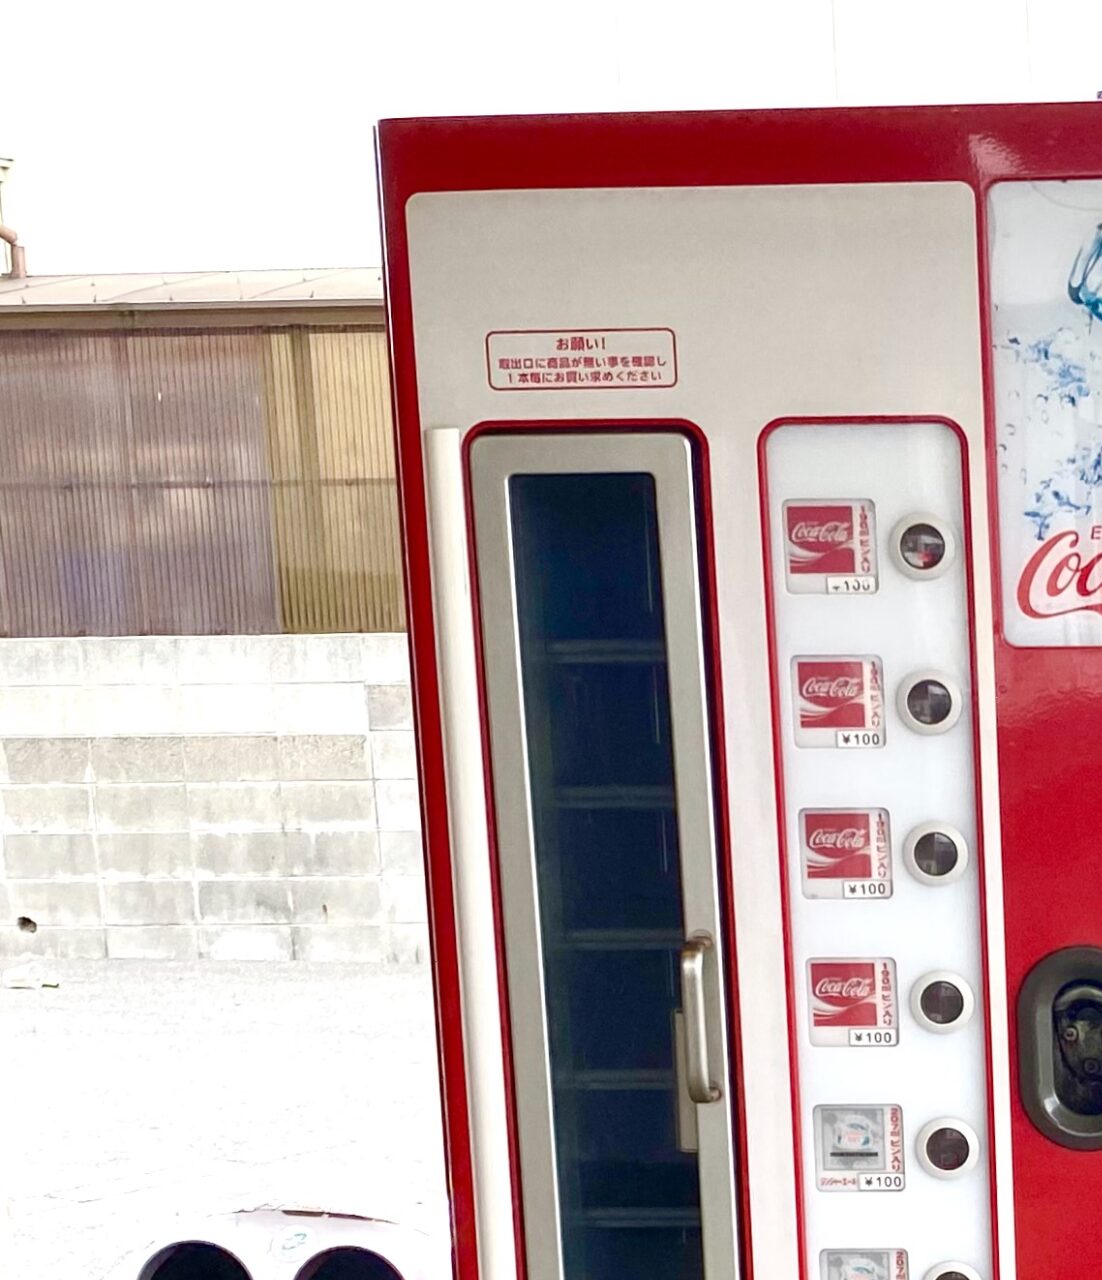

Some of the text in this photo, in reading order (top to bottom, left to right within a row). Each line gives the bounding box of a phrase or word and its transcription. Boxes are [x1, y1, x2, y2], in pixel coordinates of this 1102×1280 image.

[556, 337, 606, 351] お願い!
[791, 521, 851, 542] Coca-Cola
[802, 676, 859, 698] Coca-Cola
[842, 733, 880, 745] ¥100
[809, 828, 867, 848] Coca-Cola
[848, 883, 886, 895] ¥100
[815, 977, 874, 997] Coca-Cola
[855, 1032, 892, 1044] ¥100
[865, 1176, 902, 1188] ¥100
